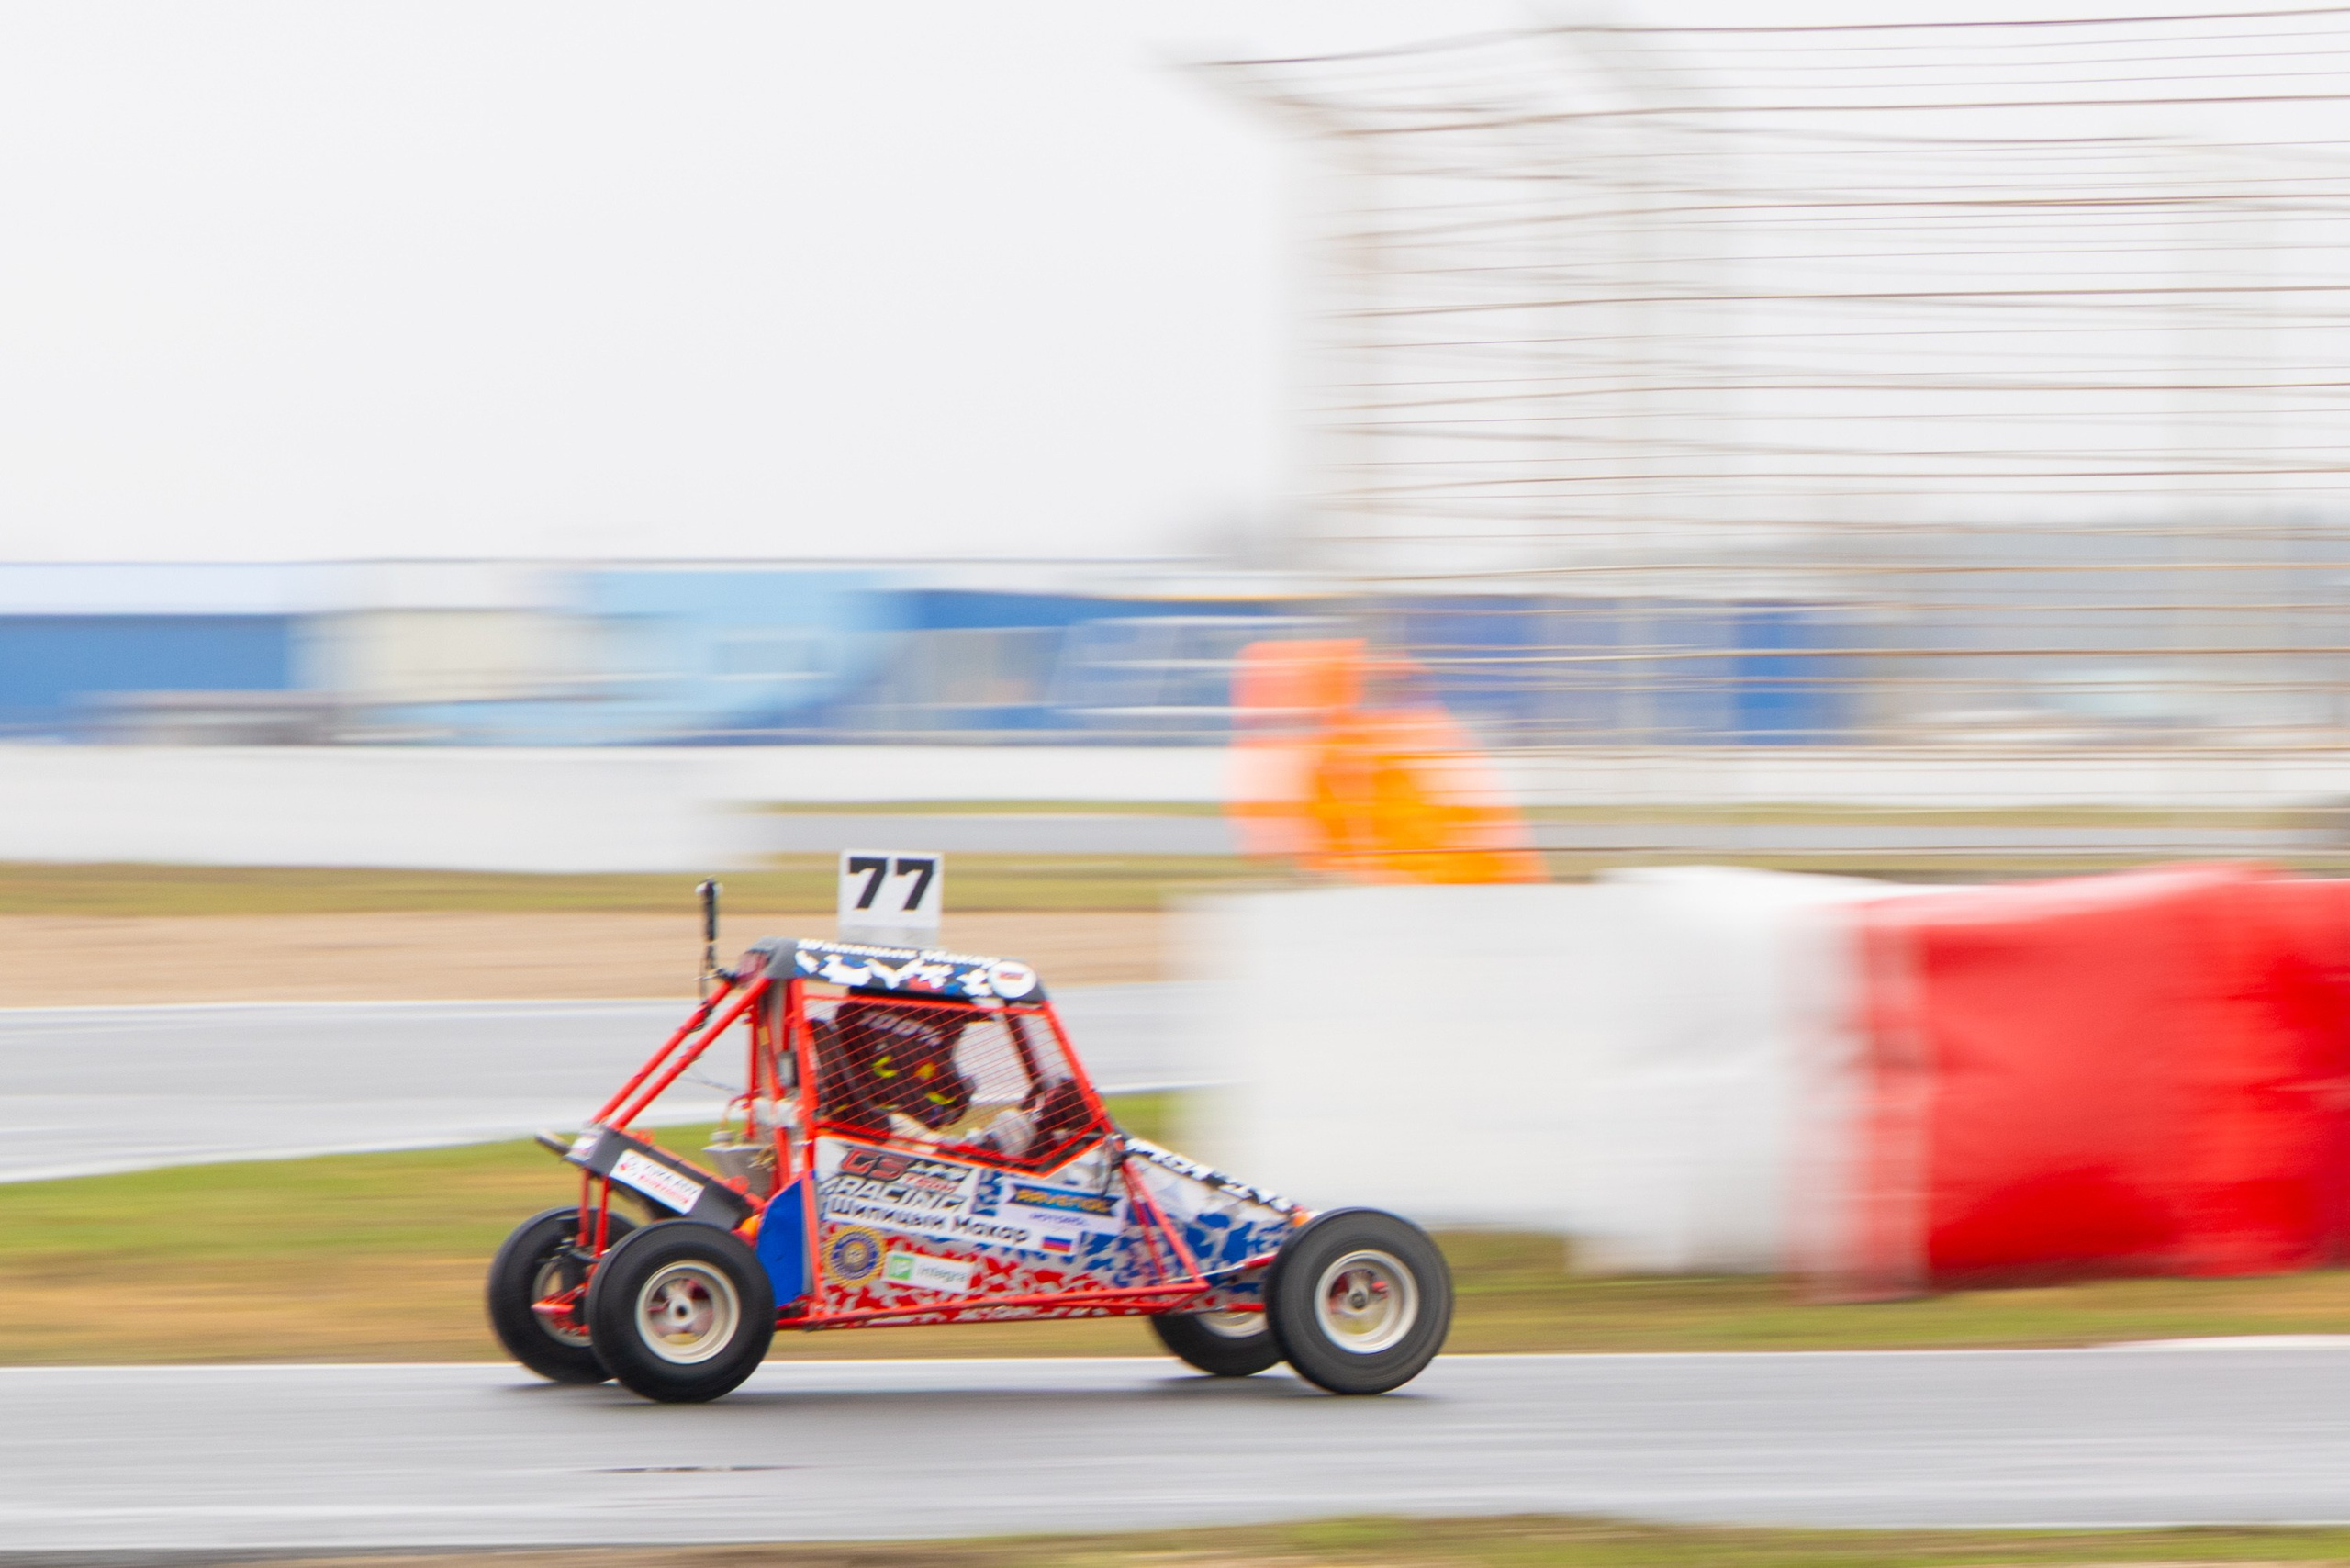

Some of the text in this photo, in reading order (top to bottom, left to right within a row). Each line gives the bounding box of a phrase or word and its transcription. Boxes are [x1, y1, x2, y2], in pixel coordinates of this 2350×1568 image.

[847, 856, 937, 912] 77
[834, 1174, 968, 1212] RACING
[950, 1215, 1030, 1243] Макар
